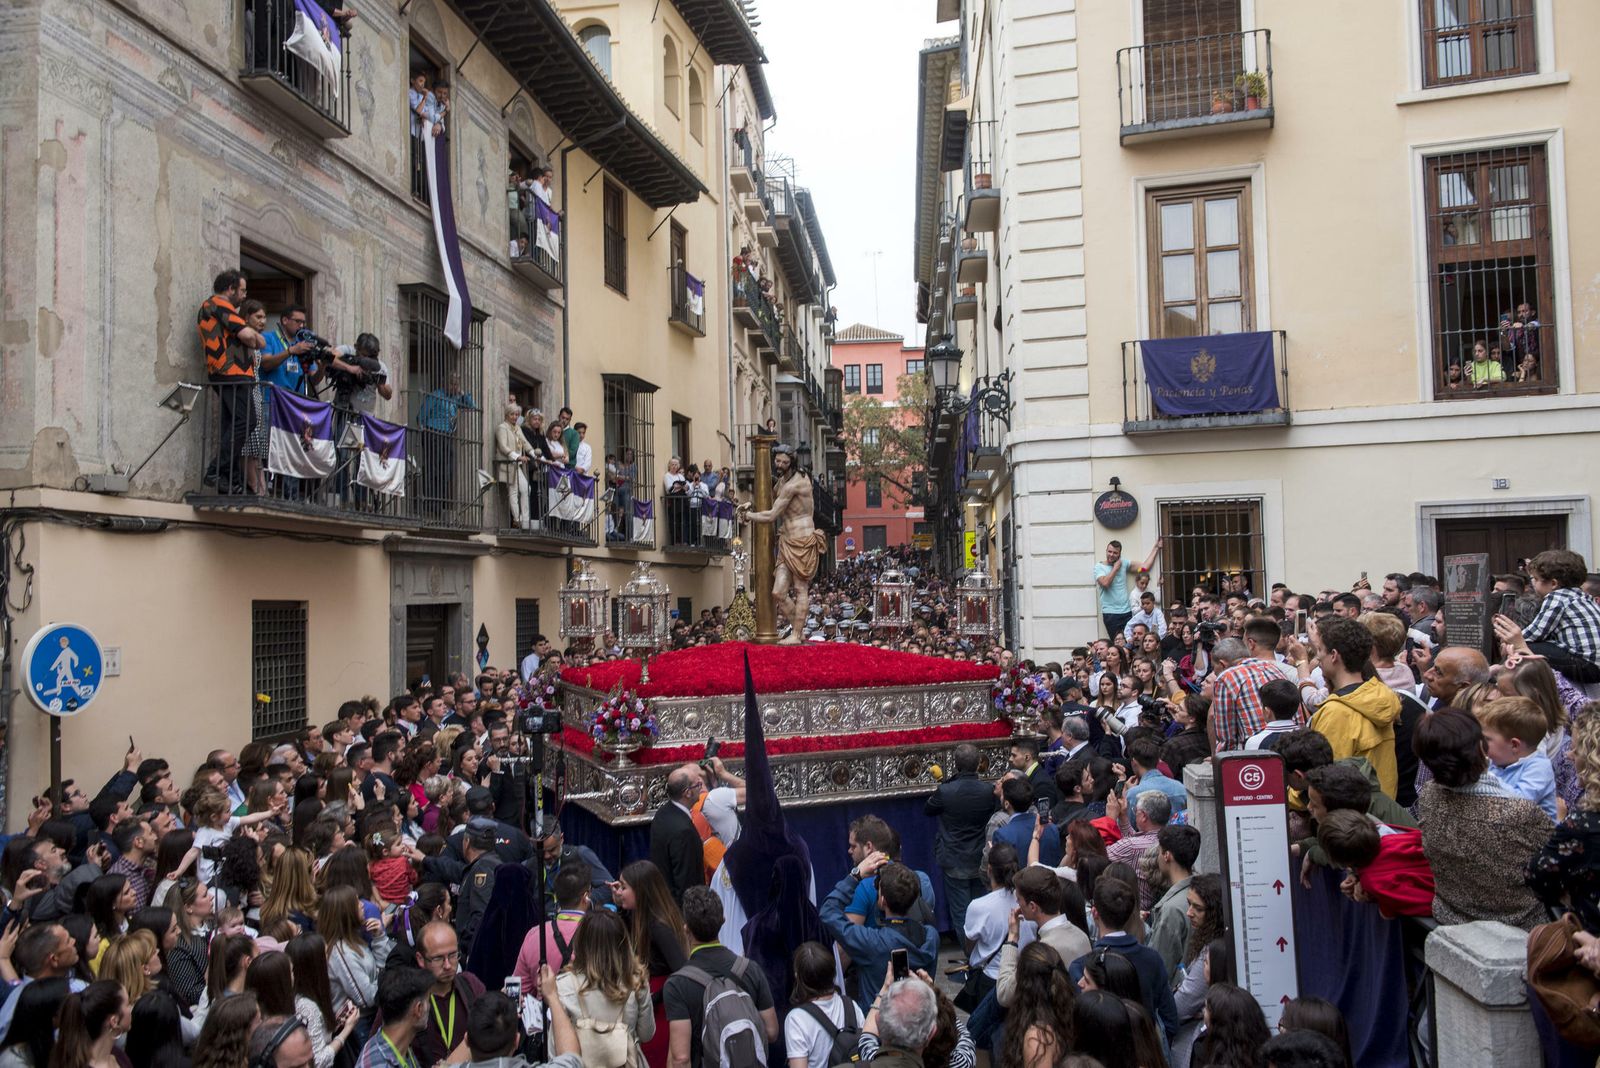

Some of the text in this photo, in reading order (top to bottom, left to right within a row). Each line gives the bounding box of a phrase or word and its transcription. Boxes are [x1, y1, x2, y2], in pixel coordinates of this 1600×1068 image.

[1157, 384, 1254, 400] Paciencia y Penas
[1243, 772, 1261, 783] C5
